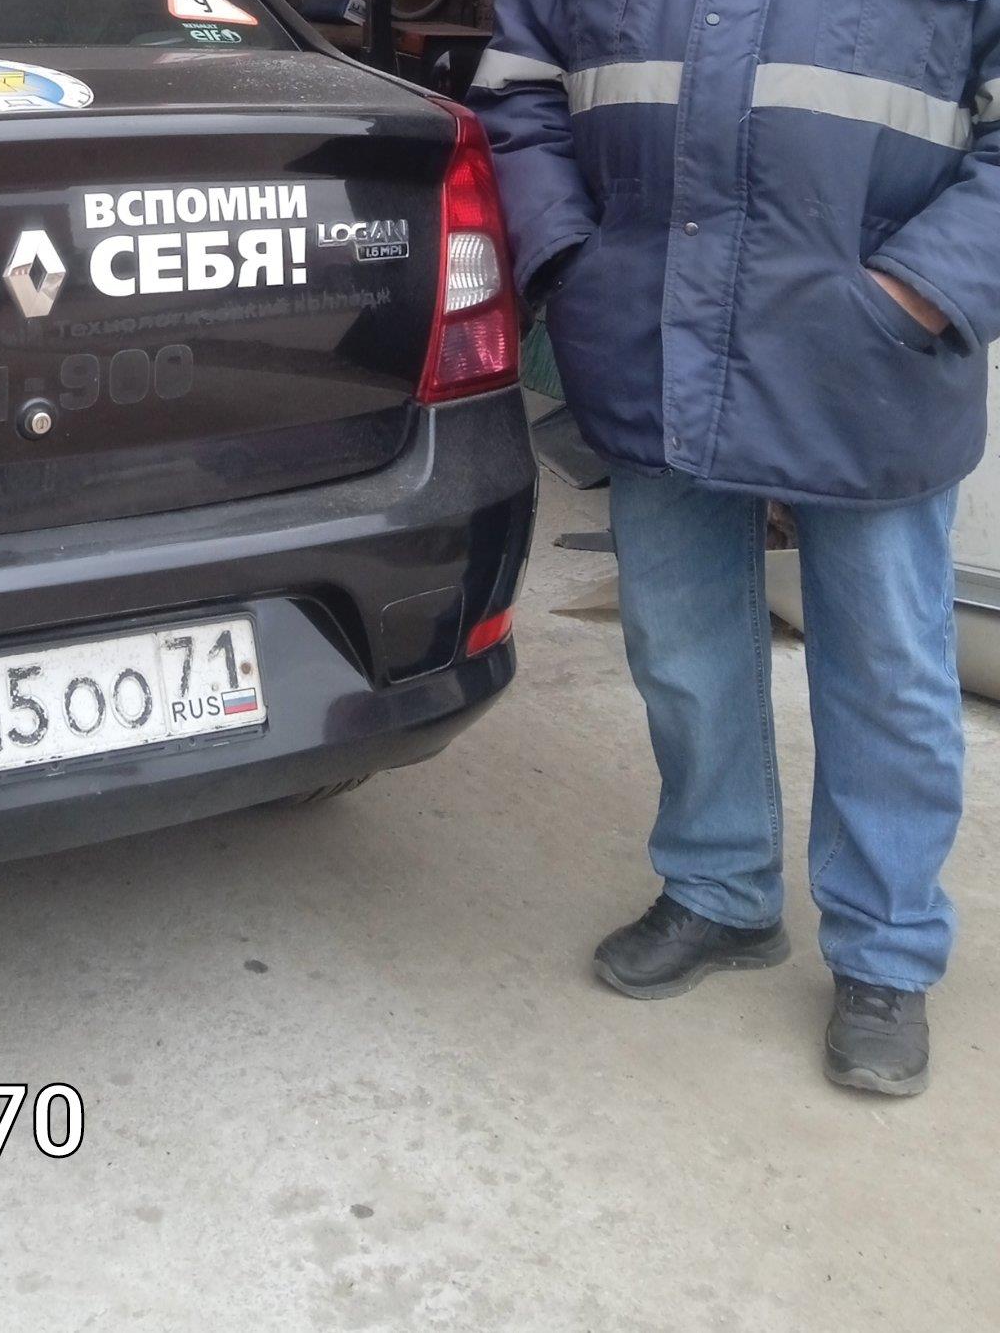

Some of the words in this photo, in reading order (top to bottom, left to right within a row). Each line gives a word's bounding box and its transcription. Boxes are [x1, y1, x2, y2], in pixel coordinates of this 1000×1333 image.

[84, 185, 308, 228] ВСПОМНИ
[317, 219, 409, 247] LOGAN
[89, 227, 308, 297] СЕБЯ!
[171, 695, 221, 724] RUS
